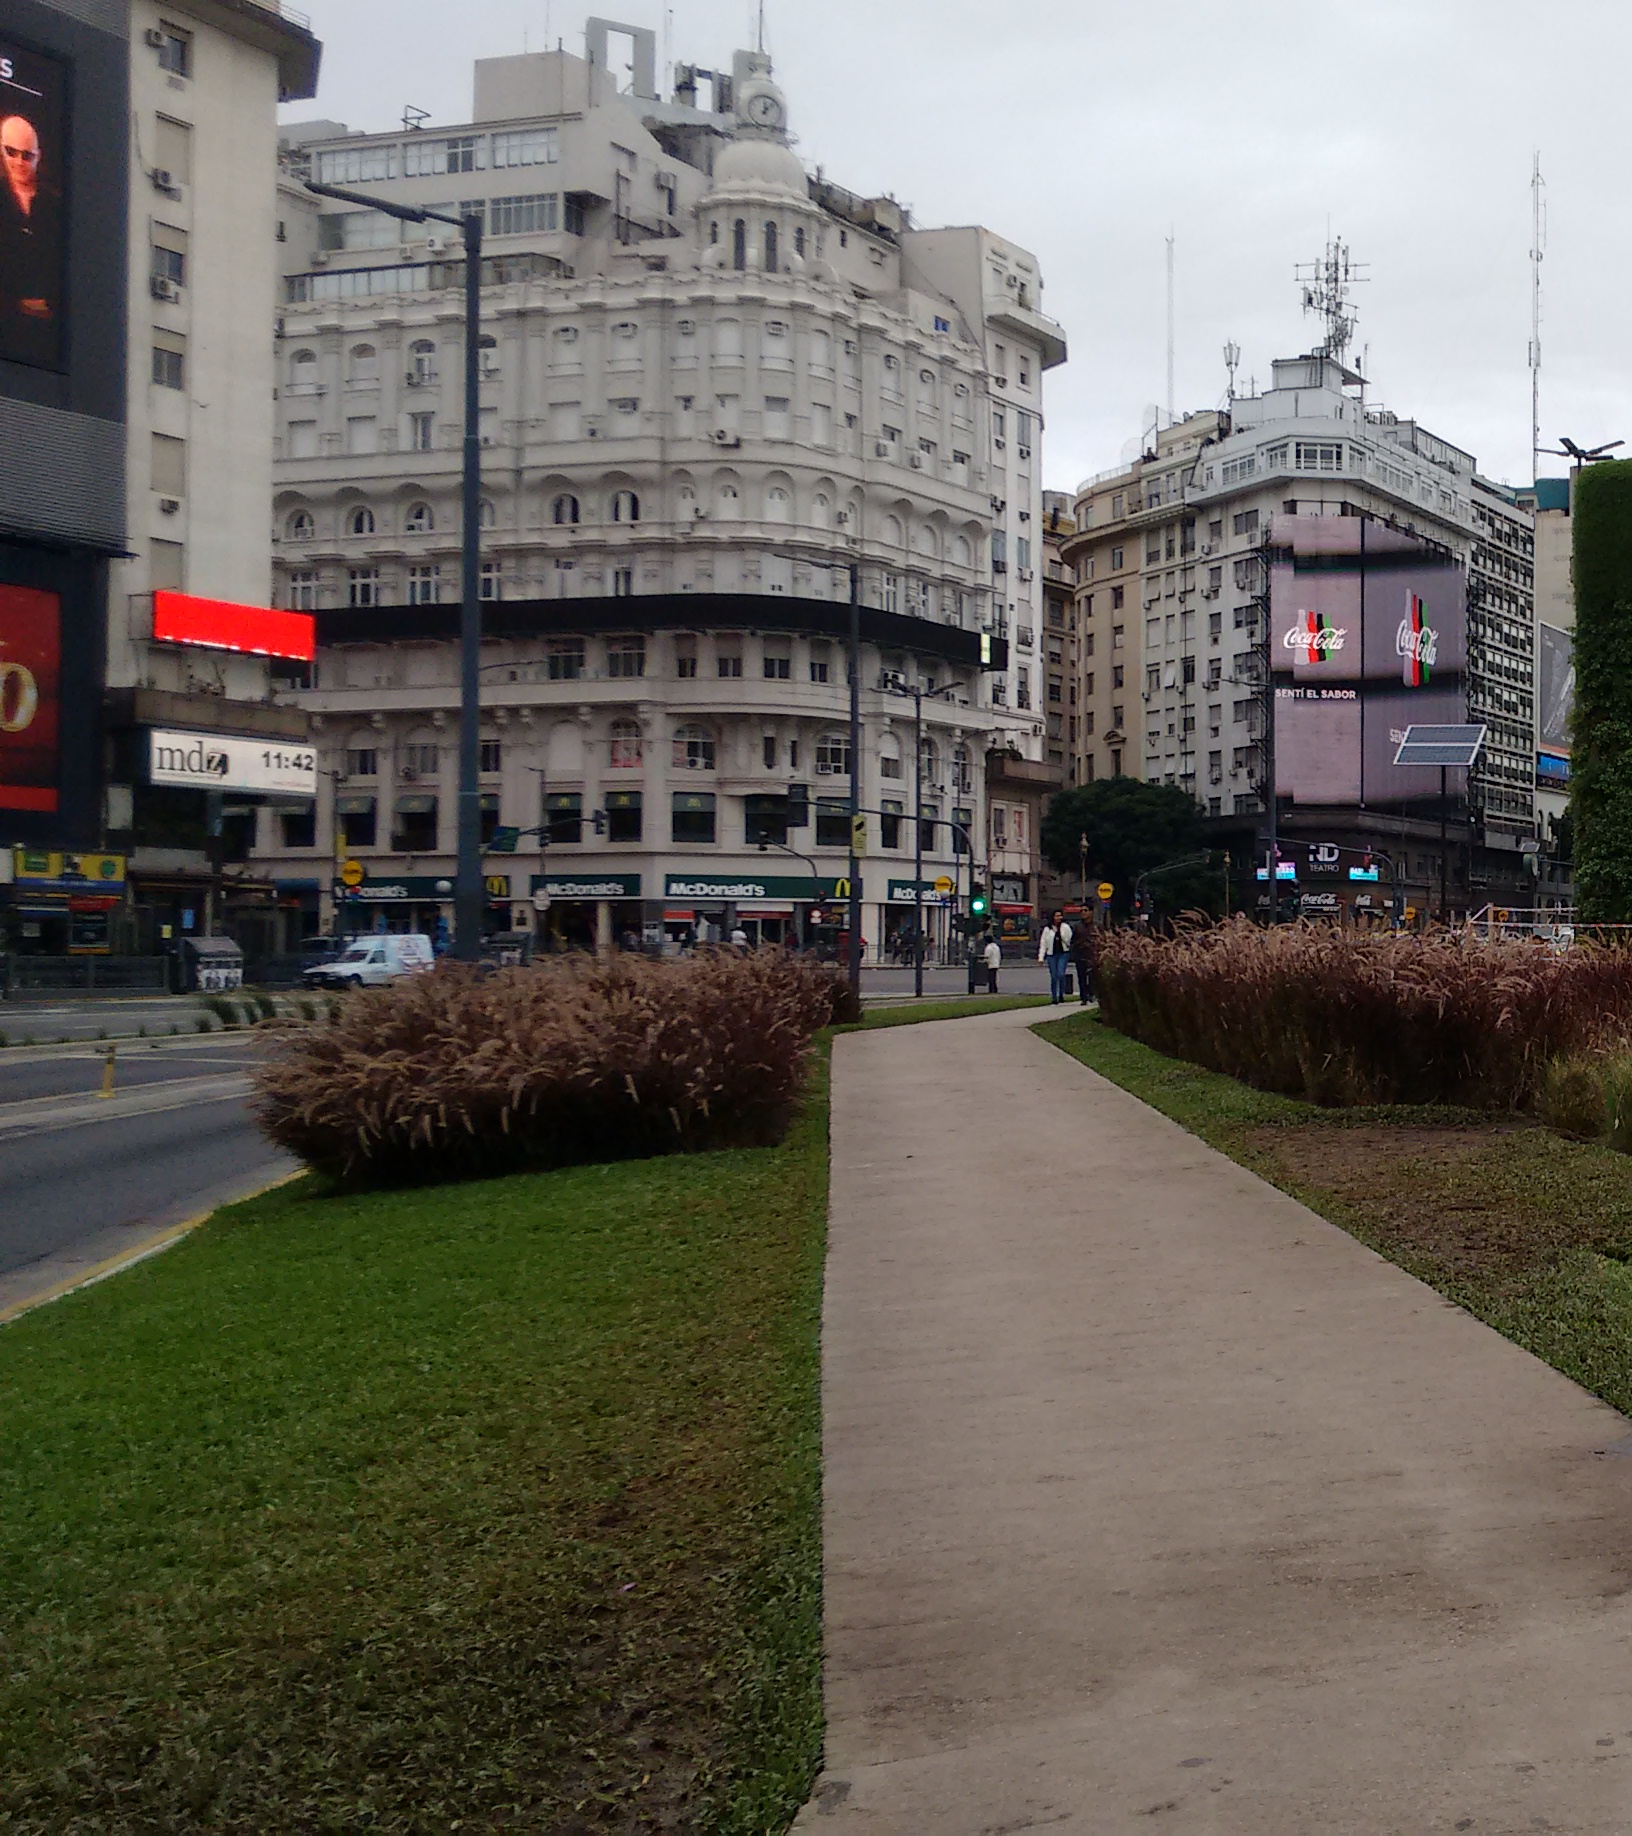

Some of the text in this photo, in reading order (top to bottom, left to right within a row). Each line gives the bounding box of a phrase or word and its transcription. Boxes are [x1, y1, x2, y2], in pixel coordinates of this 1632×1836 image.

[1275, 687, 1357, 700] SENTÍ EL SABOR
[261, 750, 315, 772] 11:42
[1308, 842, 1340, 862] ND
[1309, 864, 1340, 873] TEATRO
[545, 882, 625, 895] McDonald's
[669, 882, 766, 897] McDonald's
[892, 887, 941, 901] McDoald's
